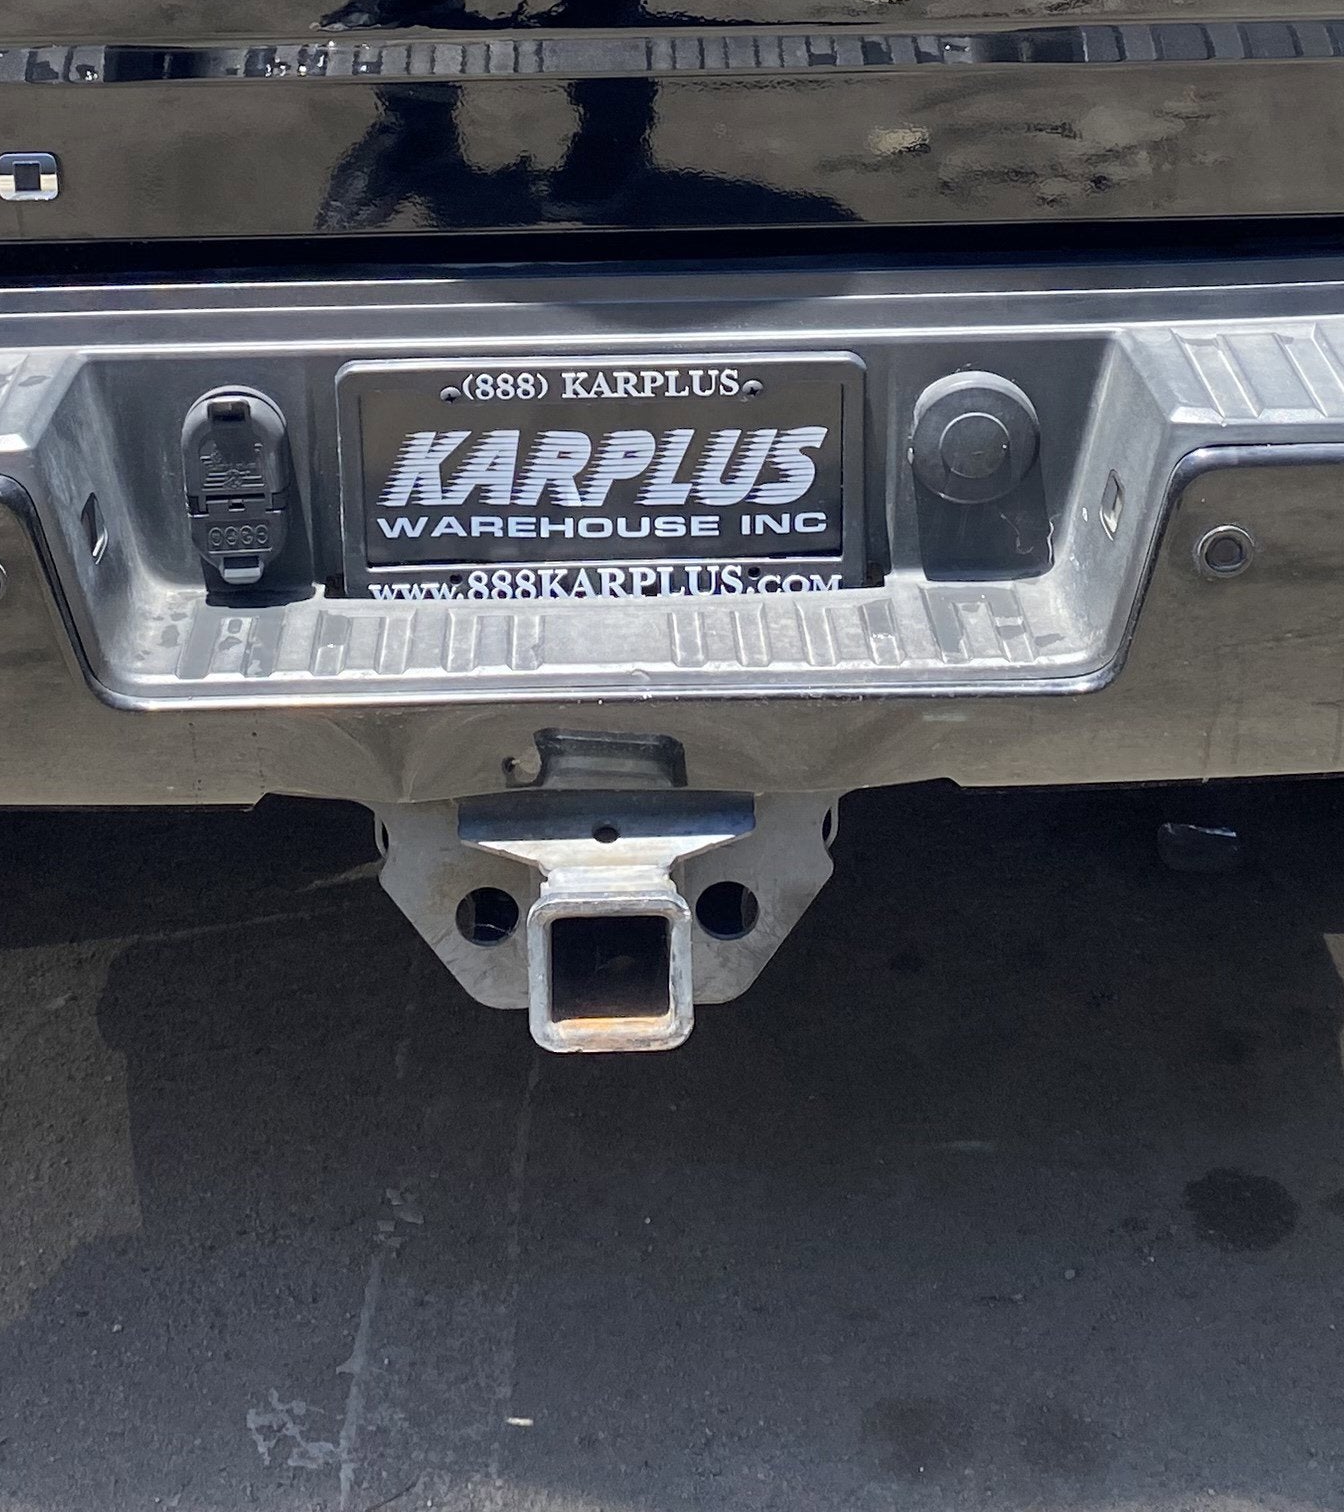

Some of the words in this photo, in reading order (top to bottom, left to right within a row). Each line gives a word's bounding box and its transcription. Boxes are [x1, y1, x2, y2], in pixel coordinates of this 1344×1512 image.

[461, 373, 549, 401] (888)
[561, 368, 739, 399] KARPLUS
[376, 426, 828, 506] KARPLUS
[376, 514, 720, 539] WAREHOUSE
[740, 511, 828, 535] INC
